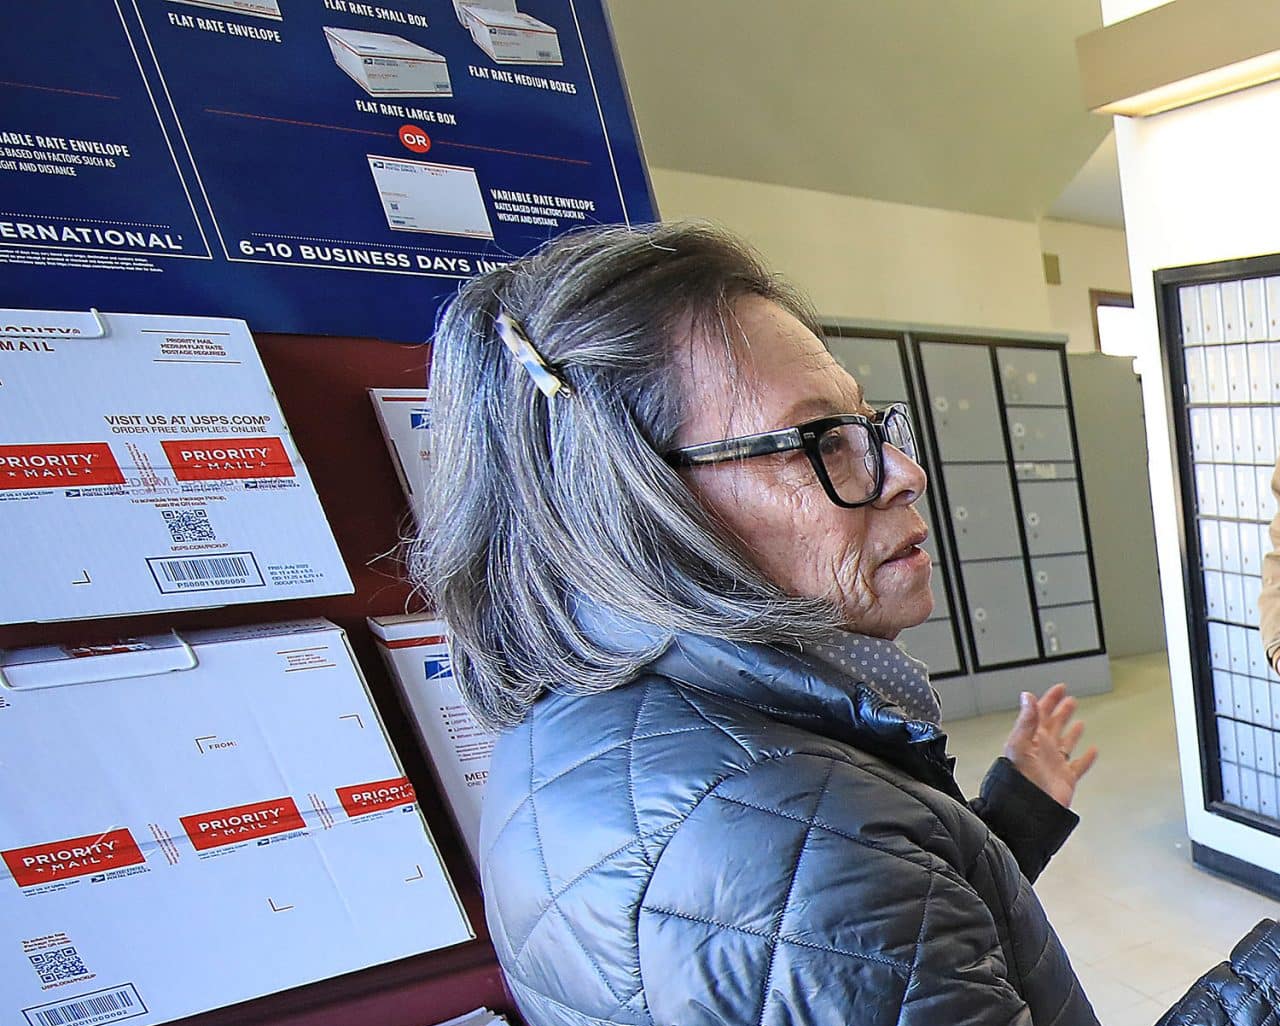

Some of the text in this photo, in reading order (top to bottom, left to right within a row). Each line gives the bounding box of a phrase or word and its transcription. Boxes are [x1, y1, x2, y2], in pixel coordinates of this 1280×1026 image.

[323, 0, 428, 28] FLAT RATE SMALL BOX
[167, 12, 282, 43] FLAT RATE ENVELOPE
[468, 65, 577, 94] FLAT RATE MEDIUM BOXES
[355, 100, 457, 125] FLAT RATE LARGE BOX
[35, 135, 69, 151] RATE
[69, 139, 131, 157] ENVELOPE
[403, 133, 428, 147] OR
[5, 147, 33, 160] BASED
[33, 151, 47, 161] ON
[48, 152, 83, 165] FACTORS
[83, 156, 104, 168] SUCH
[104, 158, 116, 168] AS
[19, 161, 38, 173] AND
[39, 163, 78, 177] DISTANCE
[490, 188, 596, 211] VARIABLE RATE ENVELOPE
[300, 244, 411, 269] BUSINESS
[416, 254, 471, 273] DAYS
[0, 340, 55, 351] MAIL
[104, 415, 143, 425] VISIT
[147, 415, 167, 425] US
[171, 415, 187, 425] AT
[112, 426, 149, 434] ORDER
[152, 426, 178, 434] FREE
[181, 426, 229, 434] SUPPLIES
[181, 447, 269, 462] PRIORITY
[24, 467, 78, 478] MAIL
[209, 461, 254, 471] MAIL
[198, 808, 280, 832] PRIORITY
[223, 822, 267, 836] MAIL
[22, 840, 115, 867] PRIORITY
[51, 856, 101, 871] MAIL
